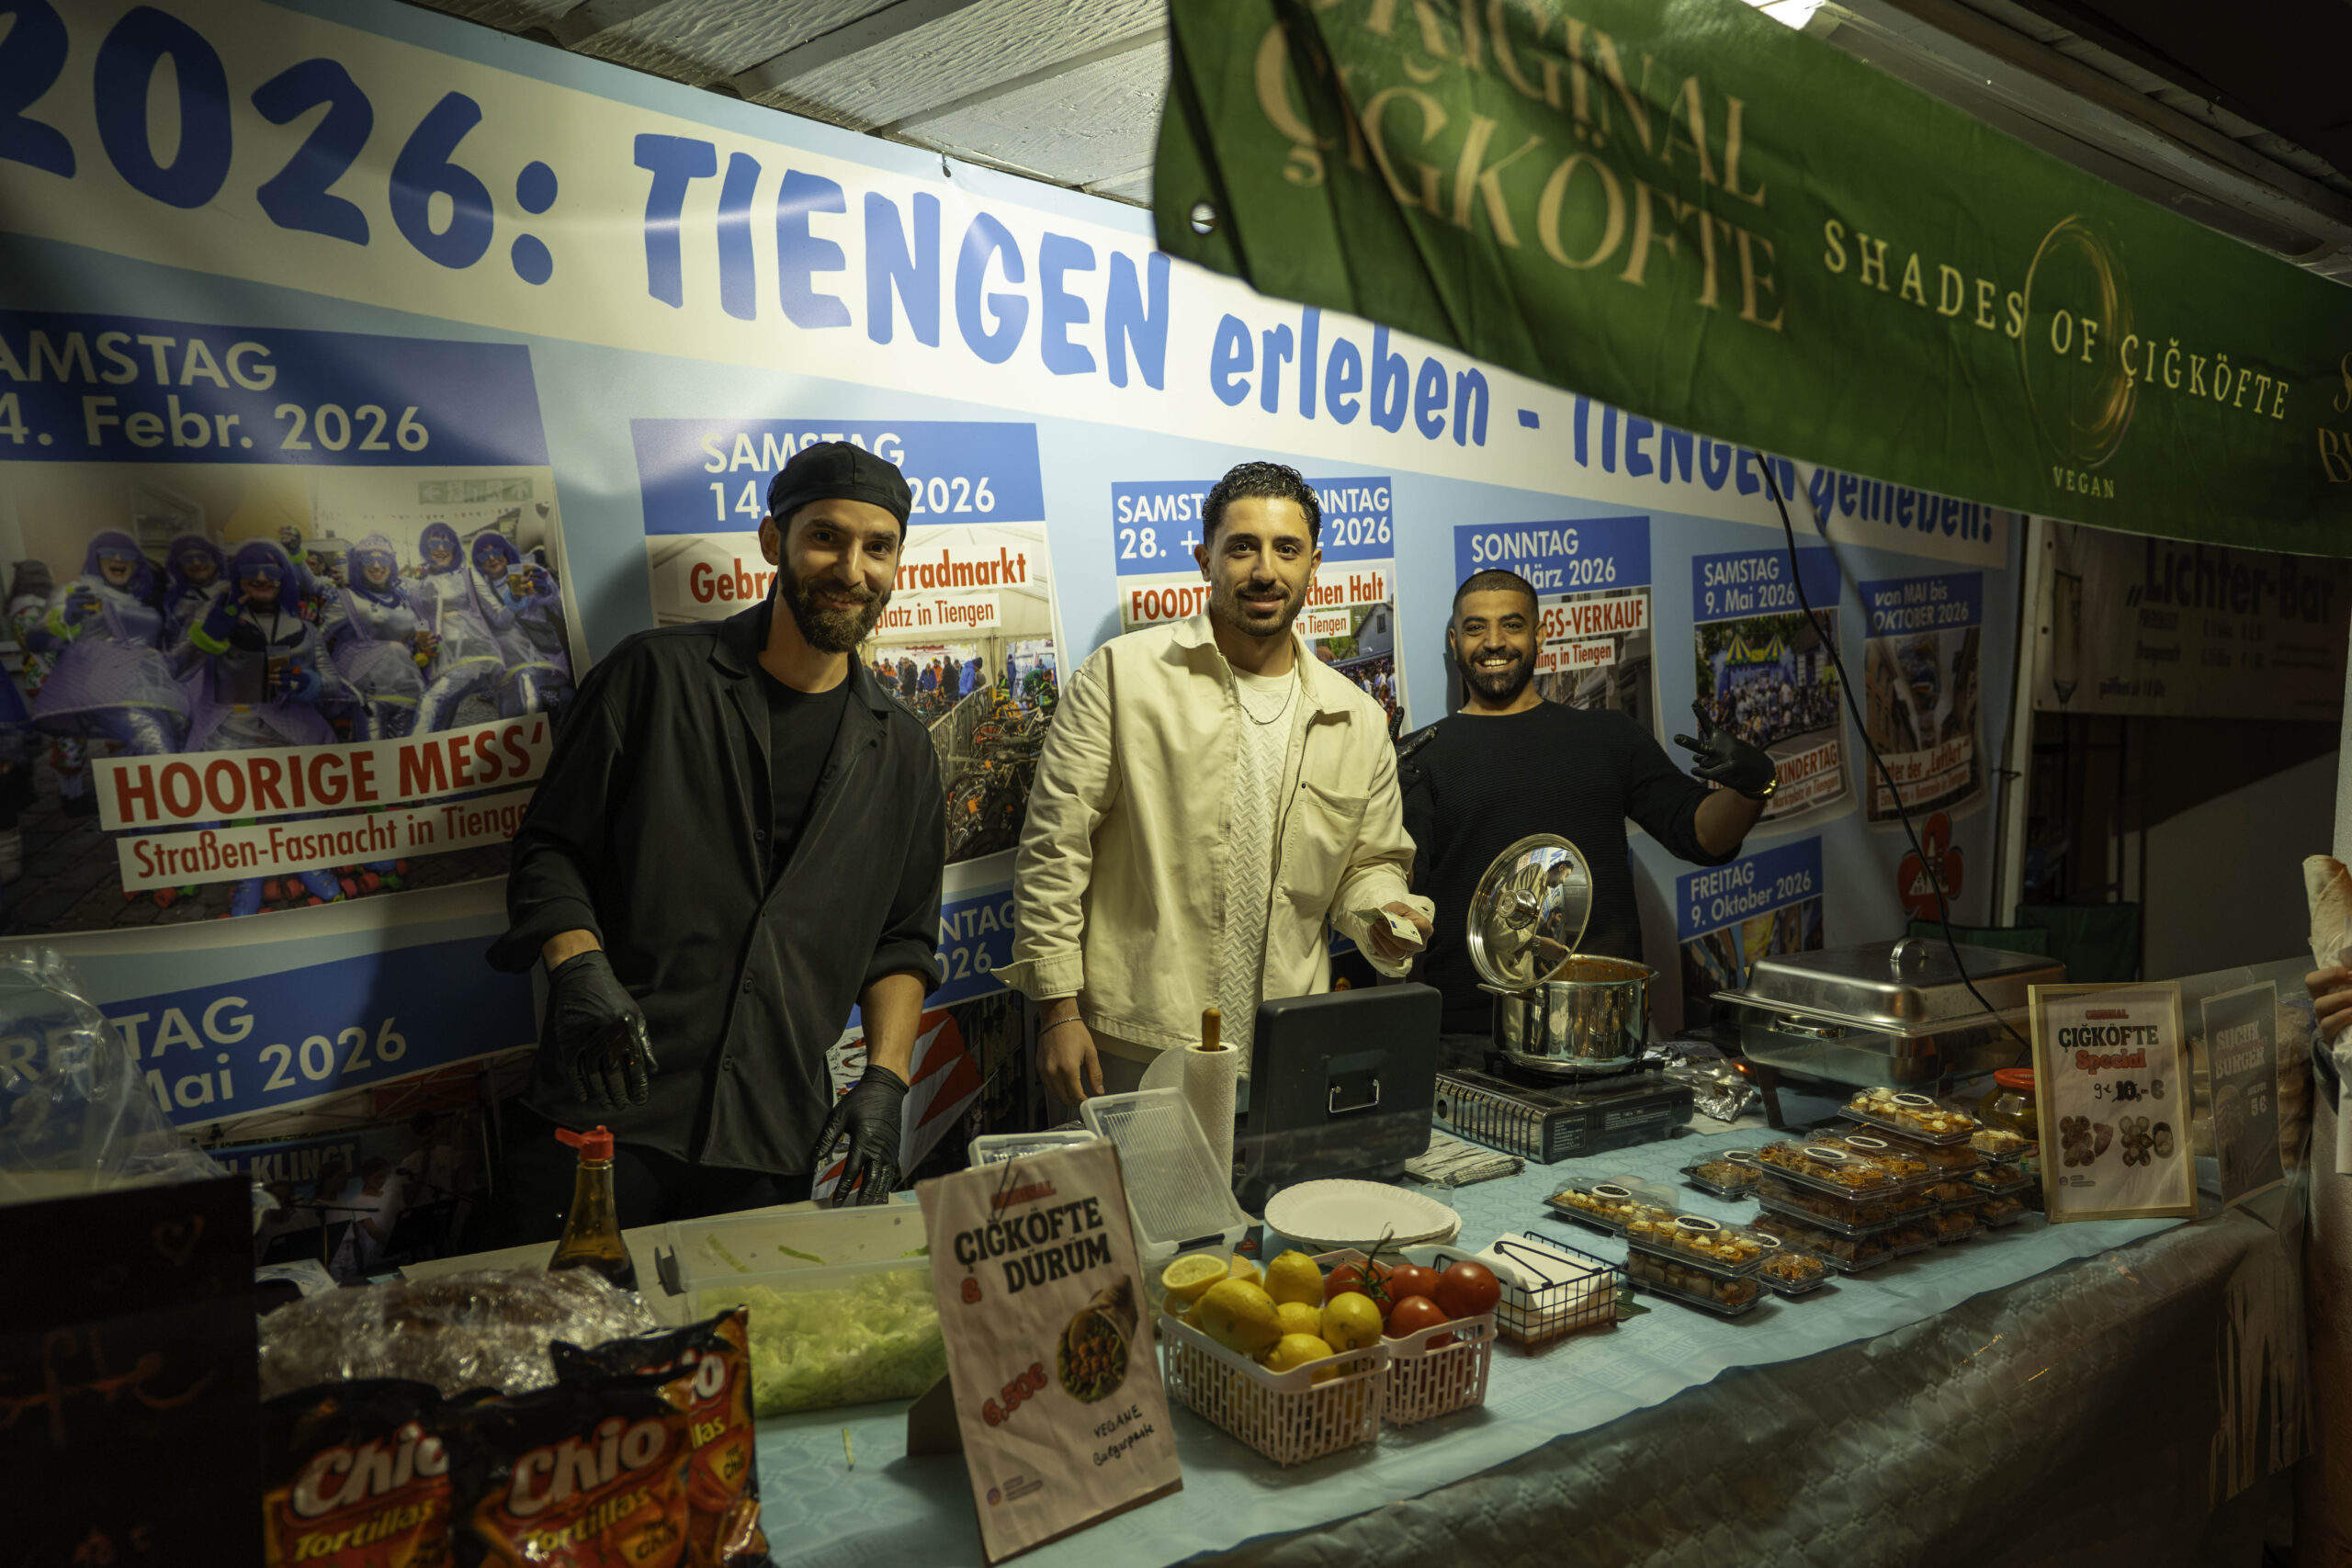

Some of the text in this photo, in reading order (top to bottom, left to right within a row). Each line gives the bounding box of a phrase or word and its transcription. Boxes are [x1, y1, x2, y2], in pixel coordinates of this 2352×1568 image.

[634, 133, 1170, 391] TIENGEN
[1210, 304, 1489, 447] erleben
[1824, 219, 2024, 339] SHADES
[2051, 310, 2099, 364] OF
[2120, 334, 2290, 420] ÇIĞKÖFTE
[82, 395, 254, 449] Febr.
[275, 403, 430, 451] 2026
[910, 477, 996, 514] 2026
[2053, 467, 2115, 500] VEGAN
[1117, 492, 1205, 524] SAMST
[1119, 527, 1168, 560] 28.
[1332, 516, 1391, 547] 2026
[1471, 527, 1579, 563] SONNTAG
[1349, 571, 1385, 604] Halt
[1568, 557, 1616, 586] 2026
[1704, 557, 1780, 587] SAMSTAG
[1705, 581, 1796, 615] 9. Mai 2026
[1874, 580, 1948, 607] von MAI bis
[918, 601, 933, 626] in
[935, 599, 995, 628] Tiengen
[1307, 614, 1347, 637] Tiengen
[1873, 600, 1970, 631] OKTOBER 2026
[1560, 646, 1570, 666] in
[1572, 643, 1611, 667] Tiengen
[113, 751, 379, 824] HOORIGE
[133, 815, 397, 879] Straßen-Fasnacht
[408, 814, 433, 846] in
[1690, 861, 1756, 902] FREITAG
[1691, 869, 1812, 929] 9. Oktober 2026
[258, 1017, 407, 1093] 2026
[2058, 1022, 2159, 1054] ÇIĞKÖFTE
[2075, 1047, 2147, 1076] Special
[954, 1196, 1104, 1274] ÇIĞKÖFTE
[1001, 1232, 1113, 1295] DÜRÜM
[1092, 1404, 1143, 1440] VEGANE
[291, 1422, 450, 1517] Chio
[506, 1417, 668, 1517] Chio
[292, 1498, 437, 1562] Tortillas
[523, 1484, 651, 1553] Tortillas
